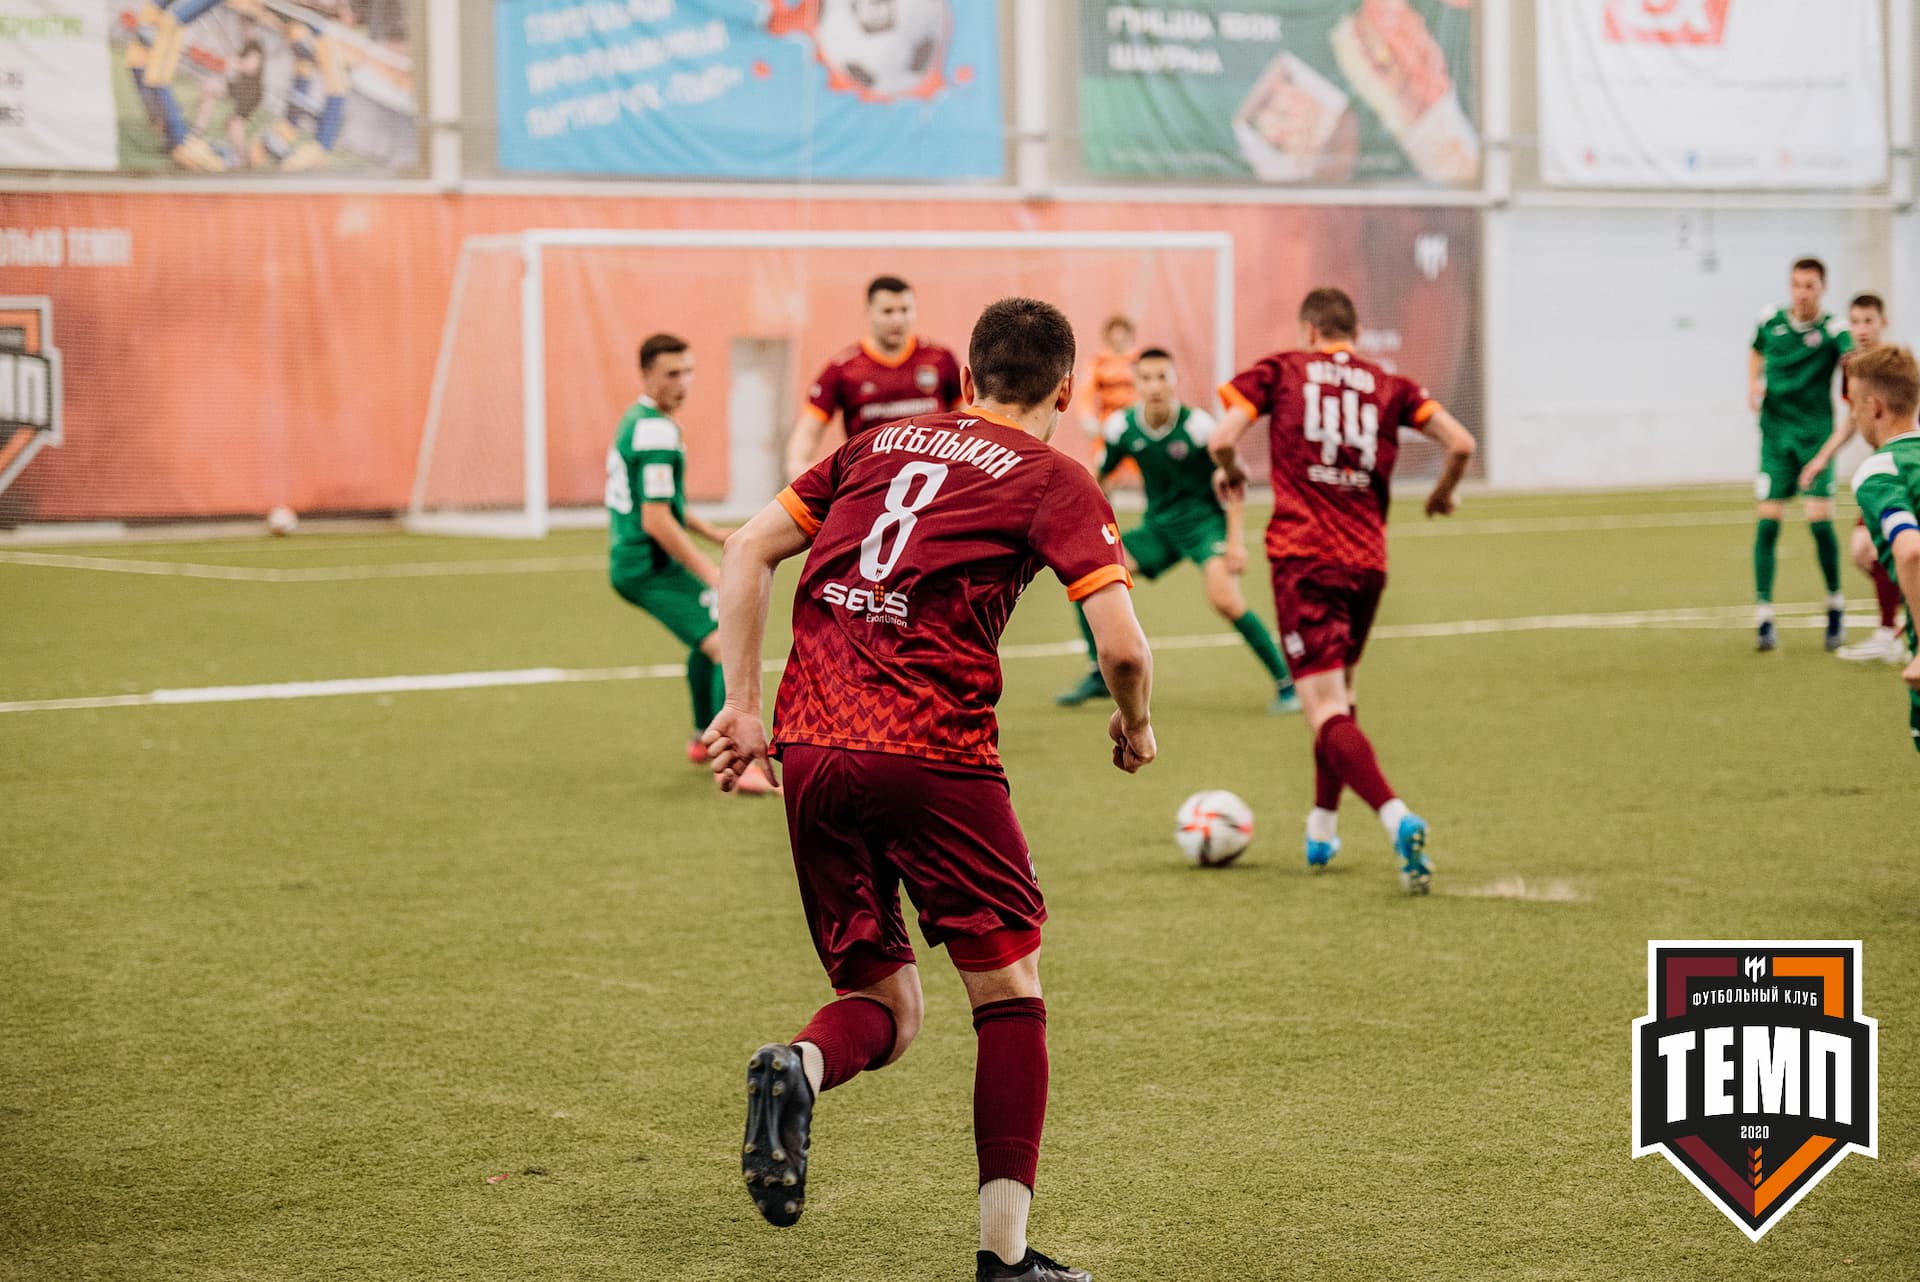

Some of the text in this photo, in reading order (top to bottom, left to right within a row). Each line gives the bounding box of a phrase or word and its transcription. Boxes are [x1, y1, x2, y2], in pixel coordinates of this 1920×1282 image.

[872, 425, 1023, 480] ЩЕБЛЫКИН
[1303, 382, 1379, 471] 44
[859, 461, 949, 582] 8
[823, 582, 909, 618] SEUS
